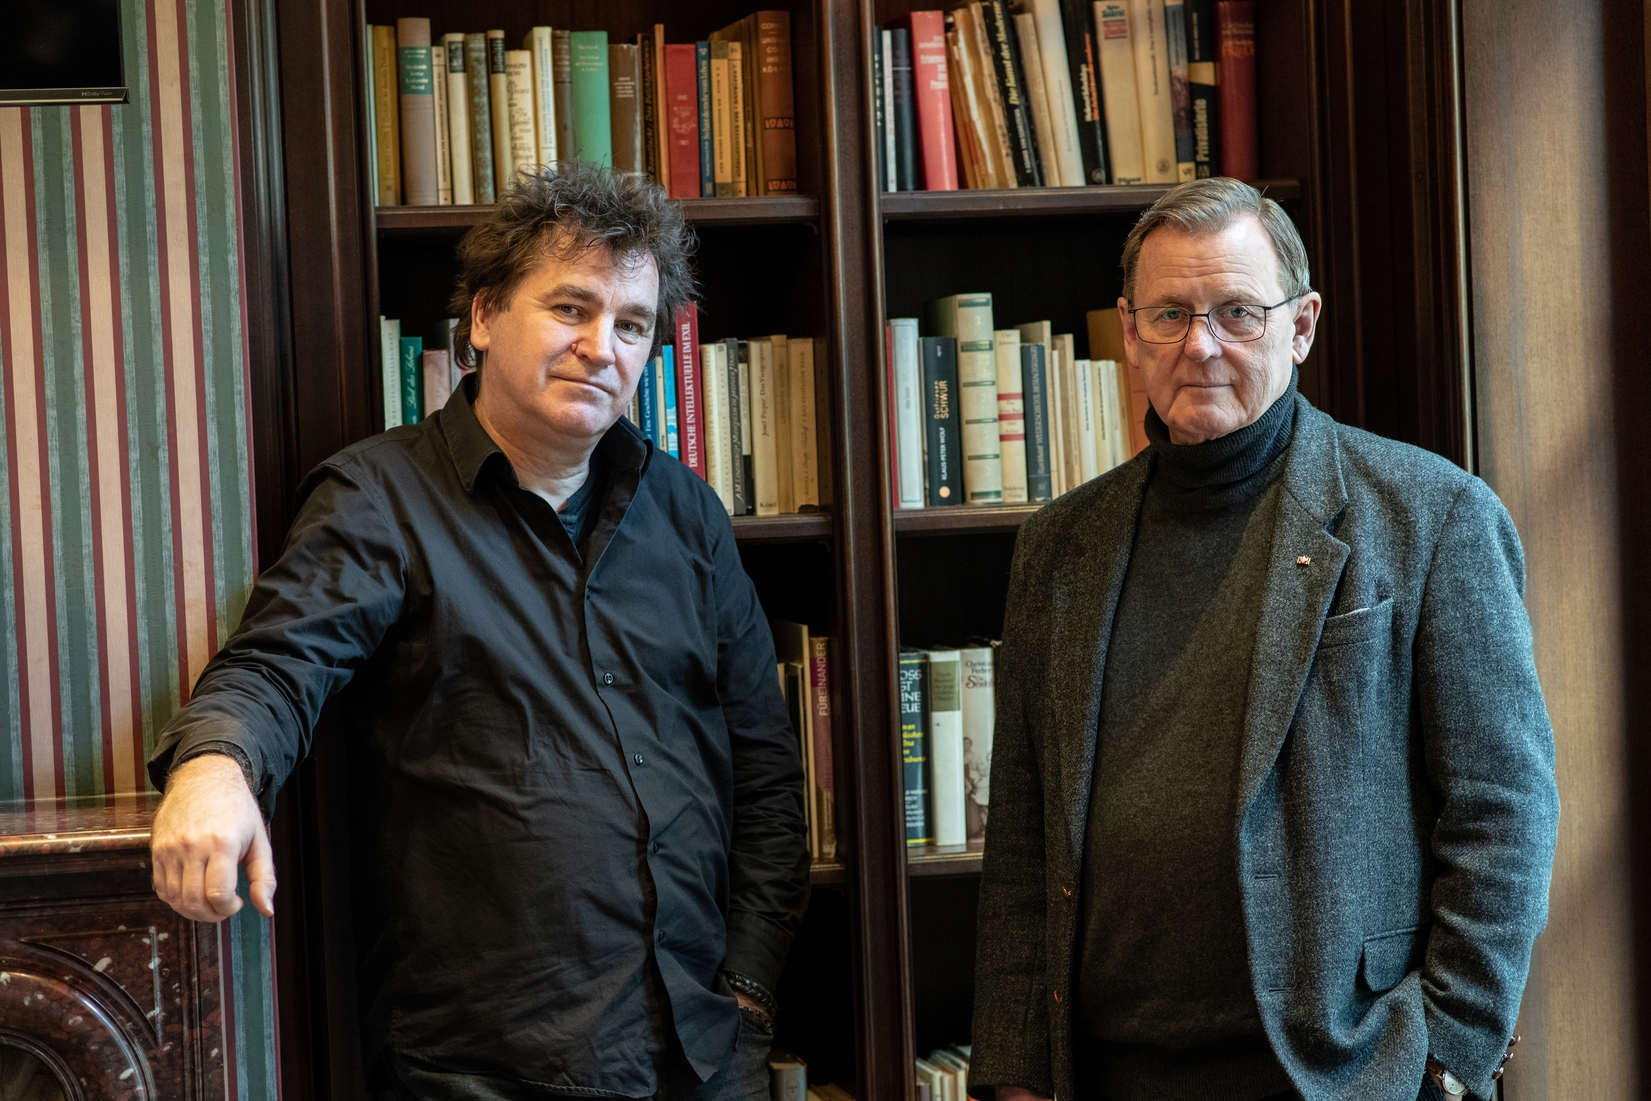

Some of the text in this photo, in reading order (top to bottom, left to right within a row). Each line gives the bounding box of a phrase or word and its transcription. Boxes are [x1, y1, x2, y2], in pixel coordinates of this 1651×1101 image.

[700, 60, 708, 80] Leben
[993, 1, 1020, 105] Die Kunst der Moderne
[758, 344, 767, 382] Viergespann
[644, 388, 652, 418] Geschichte
[682, 321, 698, 468] DEUTSCHE INTELLEKTUELLE IM EXIL
[760, 398, 768, 418] Pieper
[940, 380, 950, 419] SCHWUR
[762, 420, 770, 437] Josef
[938, 426, 948, 480] KLAUS-PETER WOLF
[816, 642, 828, 717] FÜREINANDER
